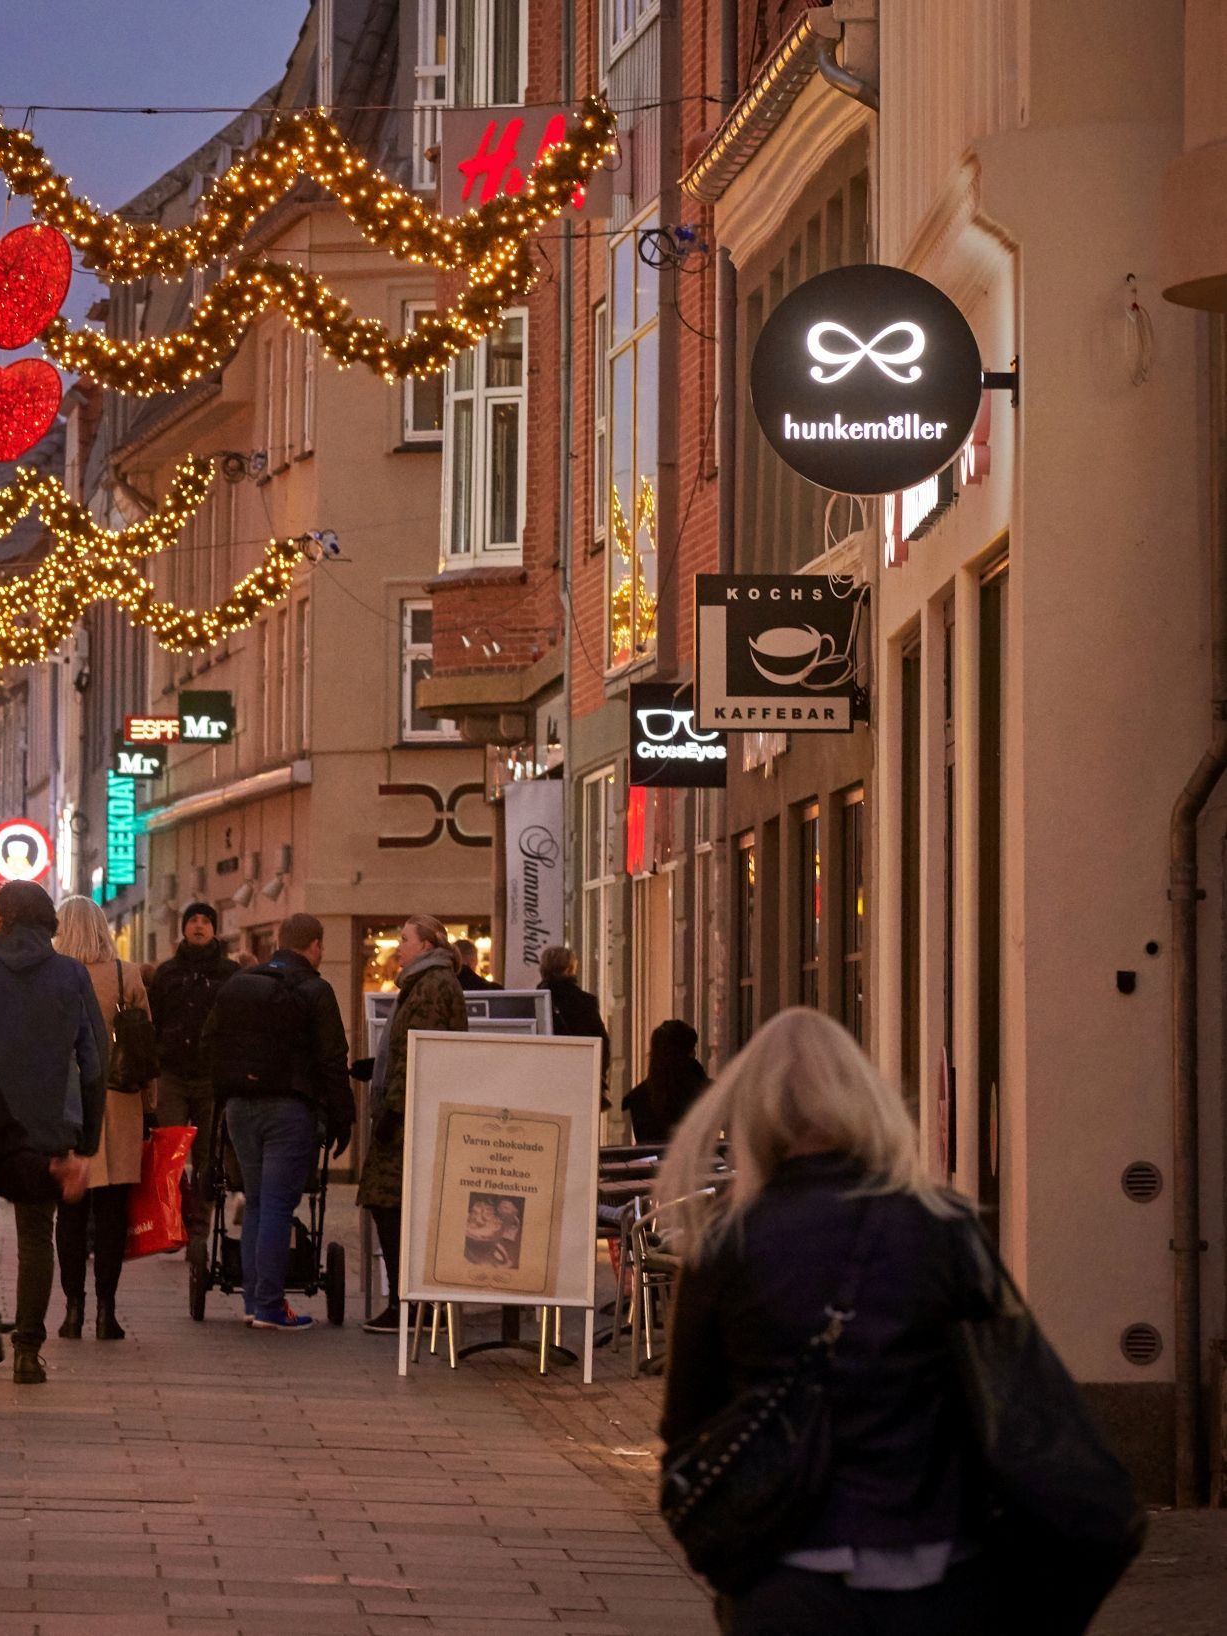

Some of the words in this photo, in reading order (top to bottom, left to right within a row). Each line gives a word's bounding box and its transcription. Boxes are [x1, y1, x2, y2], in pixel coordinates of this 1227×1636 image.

[783, 412, 949, 440] hunkemöller
[726, 587, 824, 601] KOCHS
[714, 707, 836, 720] KAFFEBAR
[130, 718, 179, 740] ESPR
[182, 715, 228, 738] Mr
[636, 741, 727, 762] CrossEyes
[117, 752, 160, 775] Mr
[518, 825, 560, 967] Summerbird
[463, 1134, 491, 1146] Varm
[492, 1139, 544, 1152] chokolade
[489, 1153, 513, 1163] eller
[470, 1166, 498, 1175] varm
[500, 1168, 531, 1178] kakao
[460, 1178, 482, 1188] med
